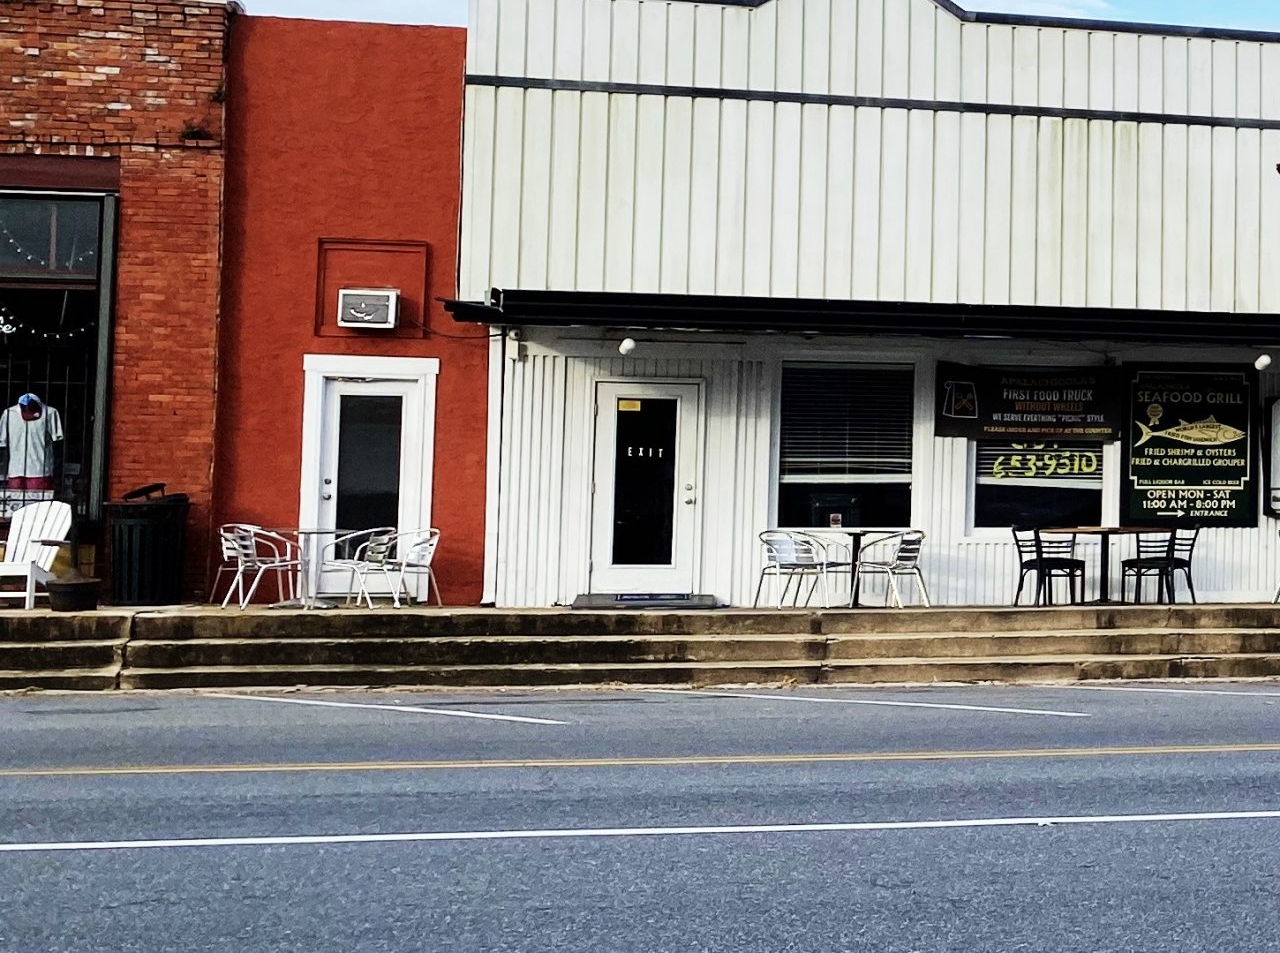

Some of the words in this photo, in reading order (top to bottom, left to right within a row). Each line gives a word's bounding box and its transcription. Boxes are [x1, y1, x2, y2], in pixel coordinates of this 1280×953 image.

[1003, 388, 1030, 401] FIRST
[1033, 389, 1060, 401] FOOD
[1062, 389, 1094, 402] TRUCK
[1137, 390, 1202, 403] SEAFOOD
[1206, 392, 1243, 404] GRILL
[1015, 401, 1052, 412] WITHOUT
[1053, 402, 1084, 412] WHEELS
[992, 413, 1002, 421] WE
[1003, 413, 1022, 422] SERVE
[1086, 413, 1104, 422] STYLE
[627, 446, 664, 458] EXIT
[1144, 447, 1166, 456] FRIED
[1167, 448, 1195, 457] SHRIMP
[1205, 448, 1236, 457] OYSTERS
[1131, 457, 1153, 466] FRIED
[1153, 458, 1161, 466] &
[1161, 458, 1212, 466] CHARGRILLED
[1212, 458, 1245, 466] GROUPER
[1147, 490, 1176, 499] OPEN
[1178, 490, 1205, 499] MON
[1212, 490, 1232, 499] SAT
[1142, 500, 1167, 509] 11:00
[1169, 500, 1188, 509] AM
[1195, 500, 1219, 509] 8:00
[1220, 500, 1236, 509] PM
